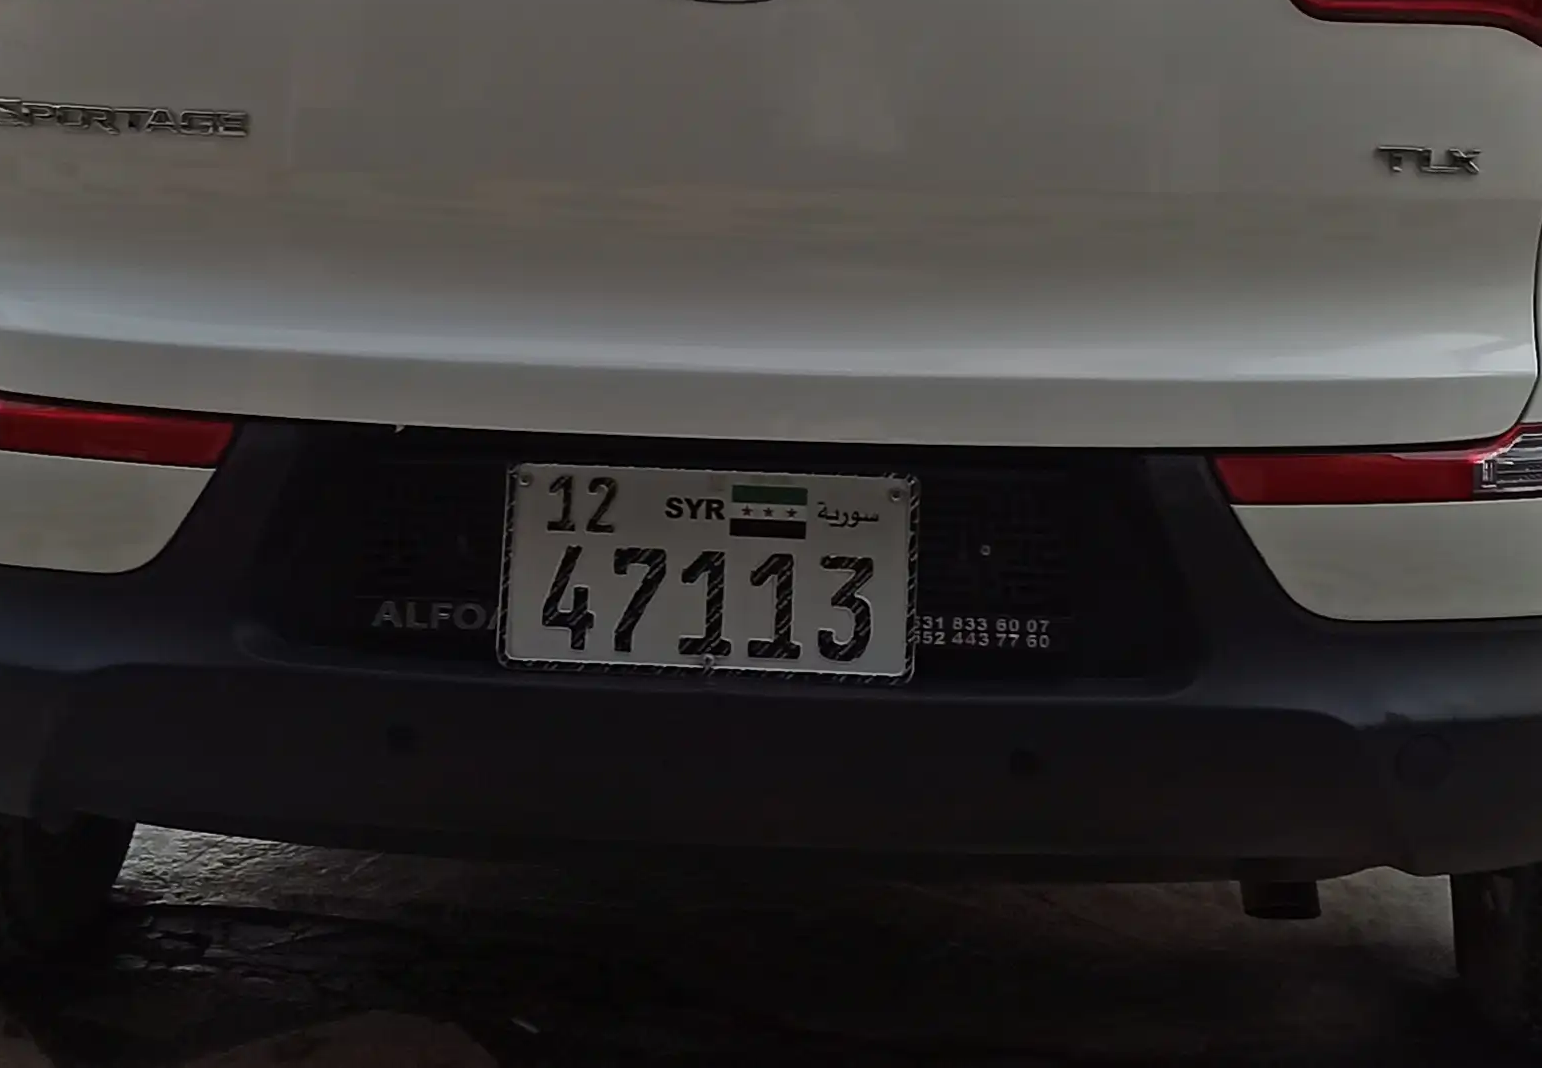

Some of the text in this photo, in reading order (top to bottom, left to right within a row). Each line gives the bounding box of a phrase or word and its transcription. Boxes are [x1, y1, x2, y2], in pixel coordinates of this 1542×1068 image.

[1376, 144, 1481, 175] TLX
[546, 474, 619, 534] 12
[664, 496, 726, 520] SYR
[816, 501, 879, 527] سورية
[541, 543, 875, 662] 47113
[952, 616, 988, 631] 833
[996, 618, 1020, 632] 60
[1026, 619, 1050, 633] 07
[951, 631, 990, 646] 443
[996, 633, 1020, 648] 77
[1026, 634, 1050, 648] 60
